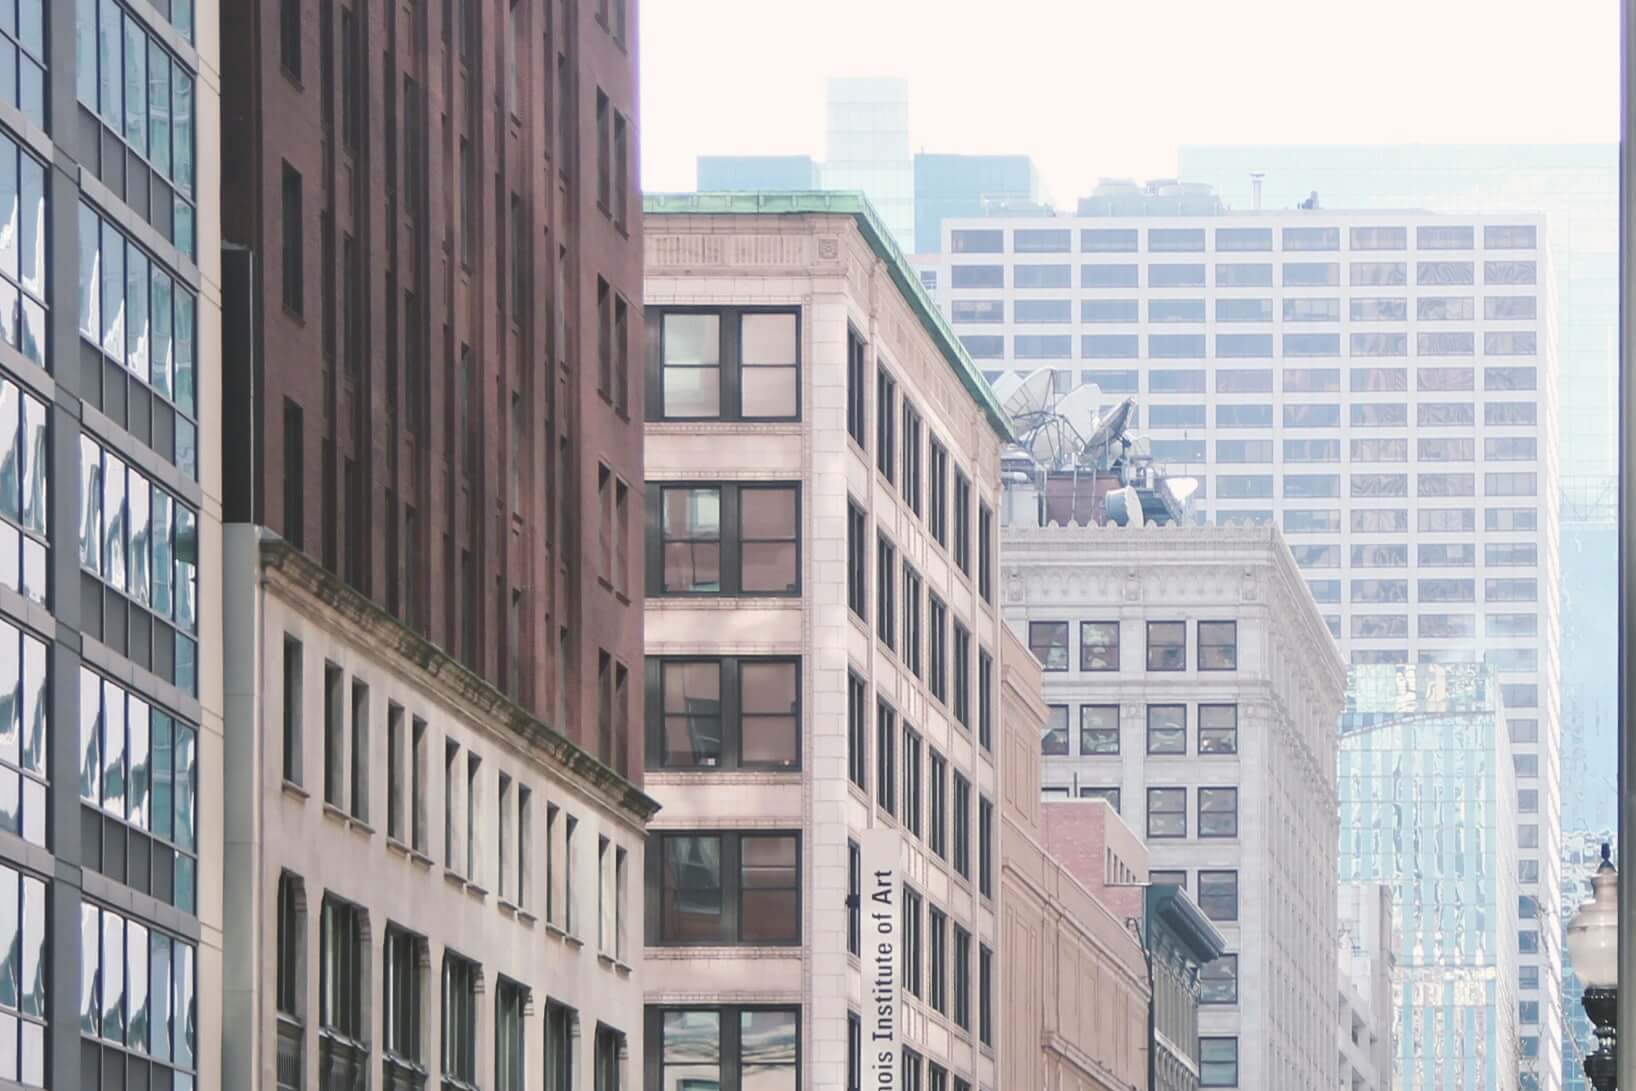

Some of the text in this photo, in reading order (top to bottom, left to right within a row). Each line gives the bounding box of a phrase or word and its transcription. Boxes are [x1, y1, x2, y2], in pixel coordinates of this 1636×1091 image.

[871, 869, 893, 905] Art
[871, 913, 893, 934] of
[872, 942, 893, 1042] Institute
